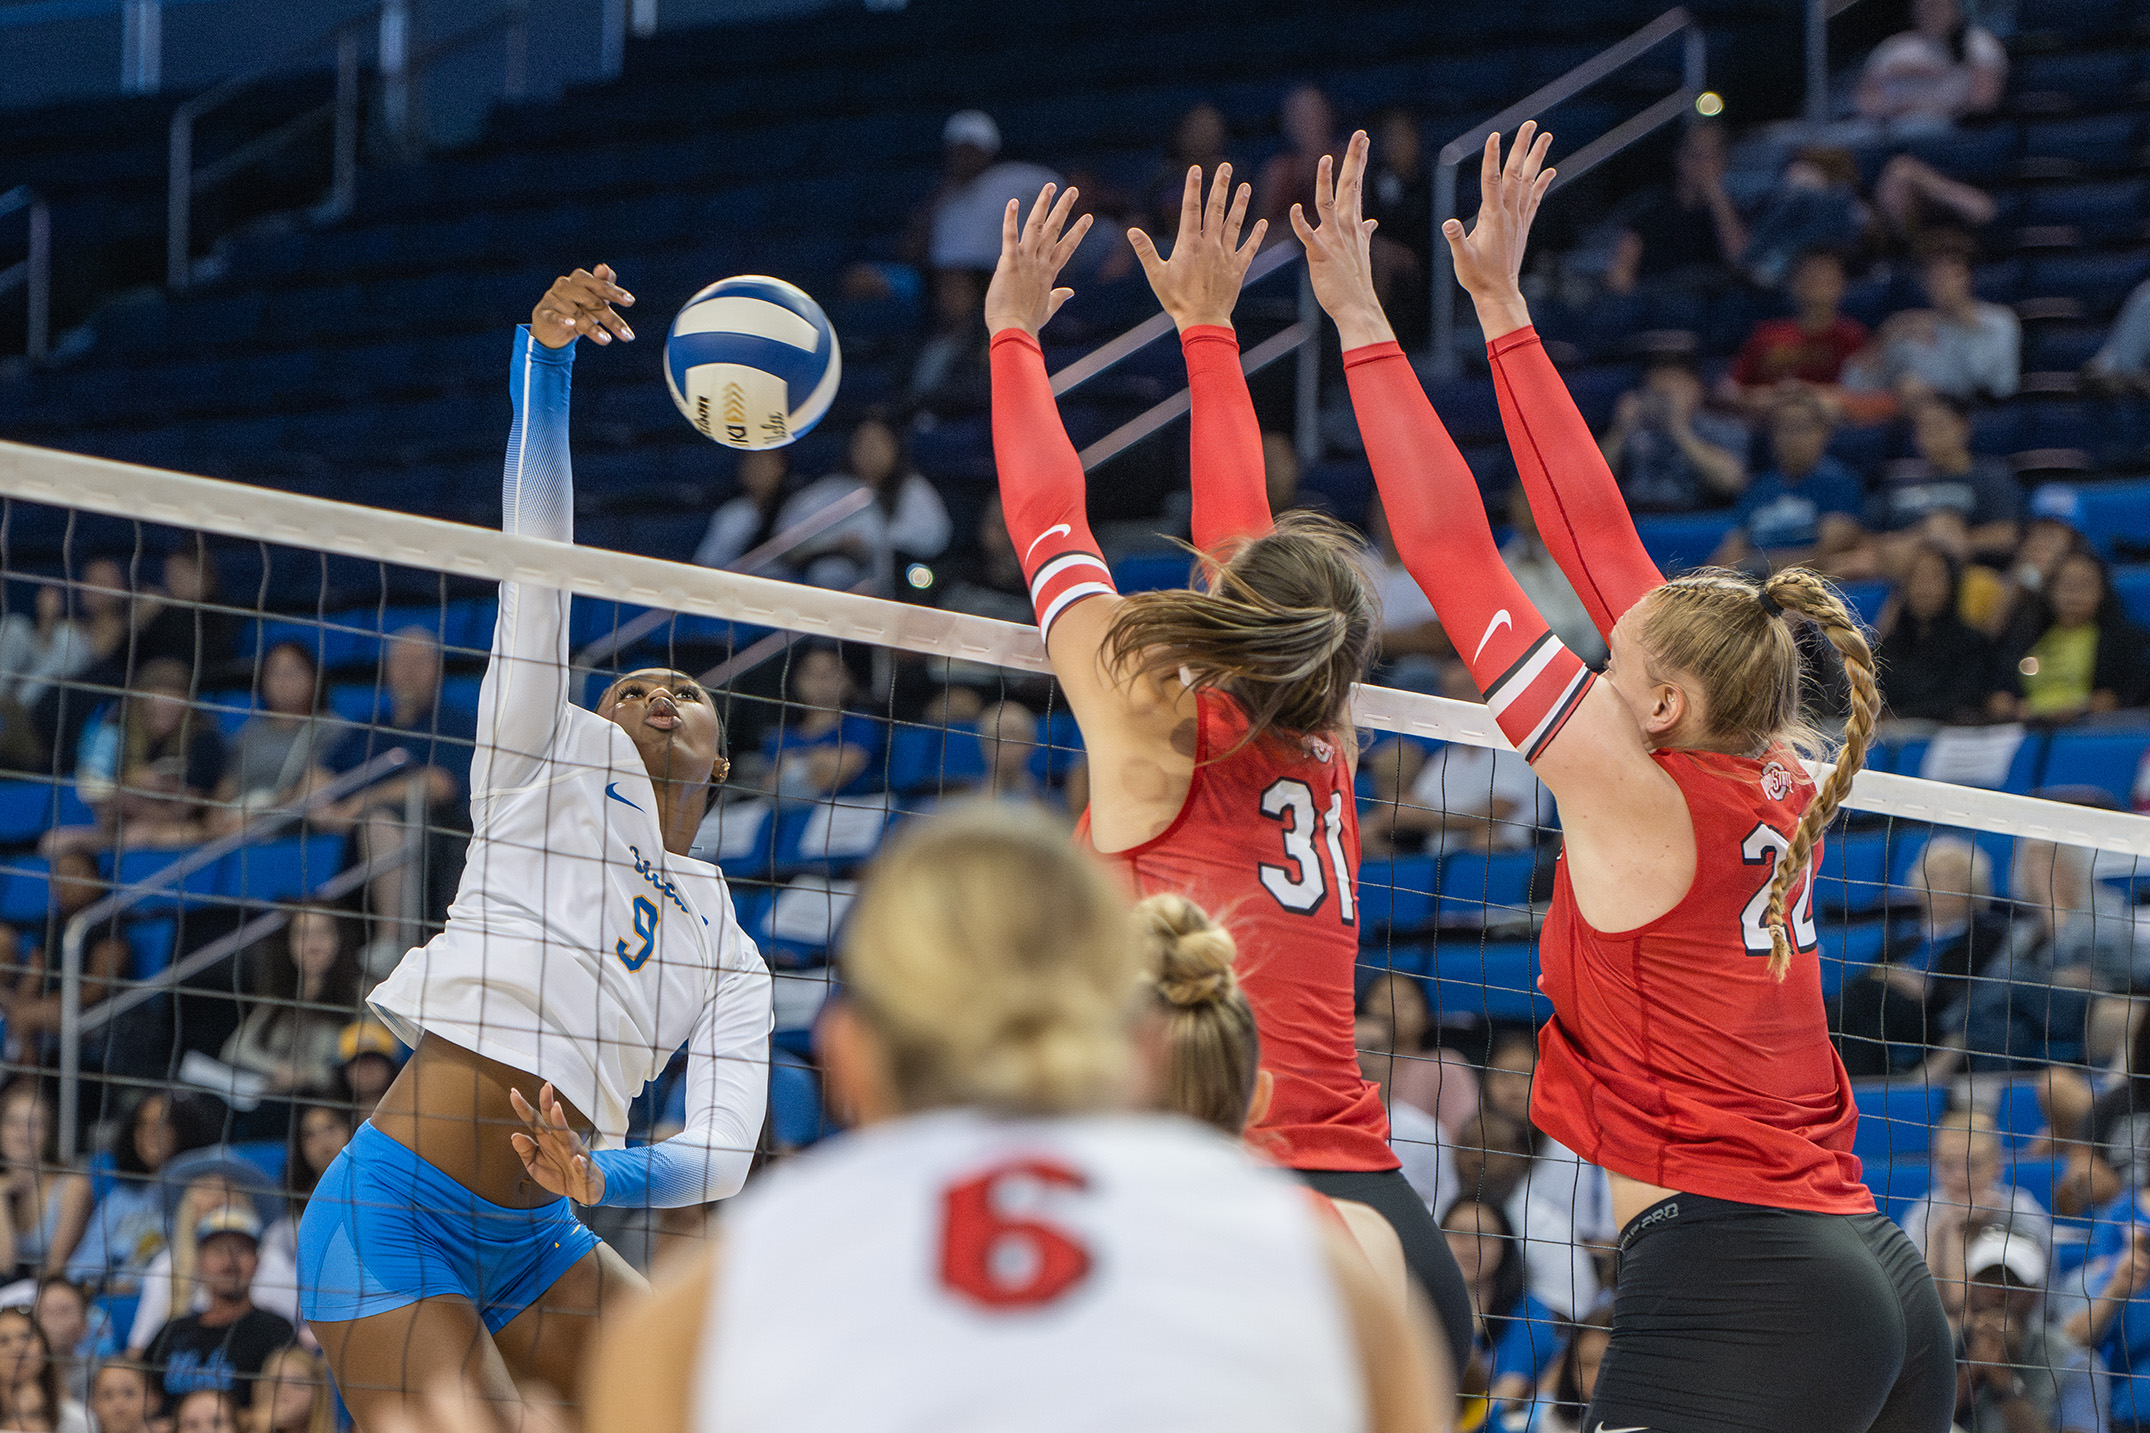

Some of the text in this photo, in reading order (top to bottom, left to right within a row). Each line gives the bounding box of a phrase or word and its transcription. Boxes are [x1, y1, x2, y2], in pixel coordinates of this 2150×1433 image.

[1258, 776, 1355, 927] 31
[615, 894, 660, 974] 9
[938, 1158, 1095, 1309] 6
